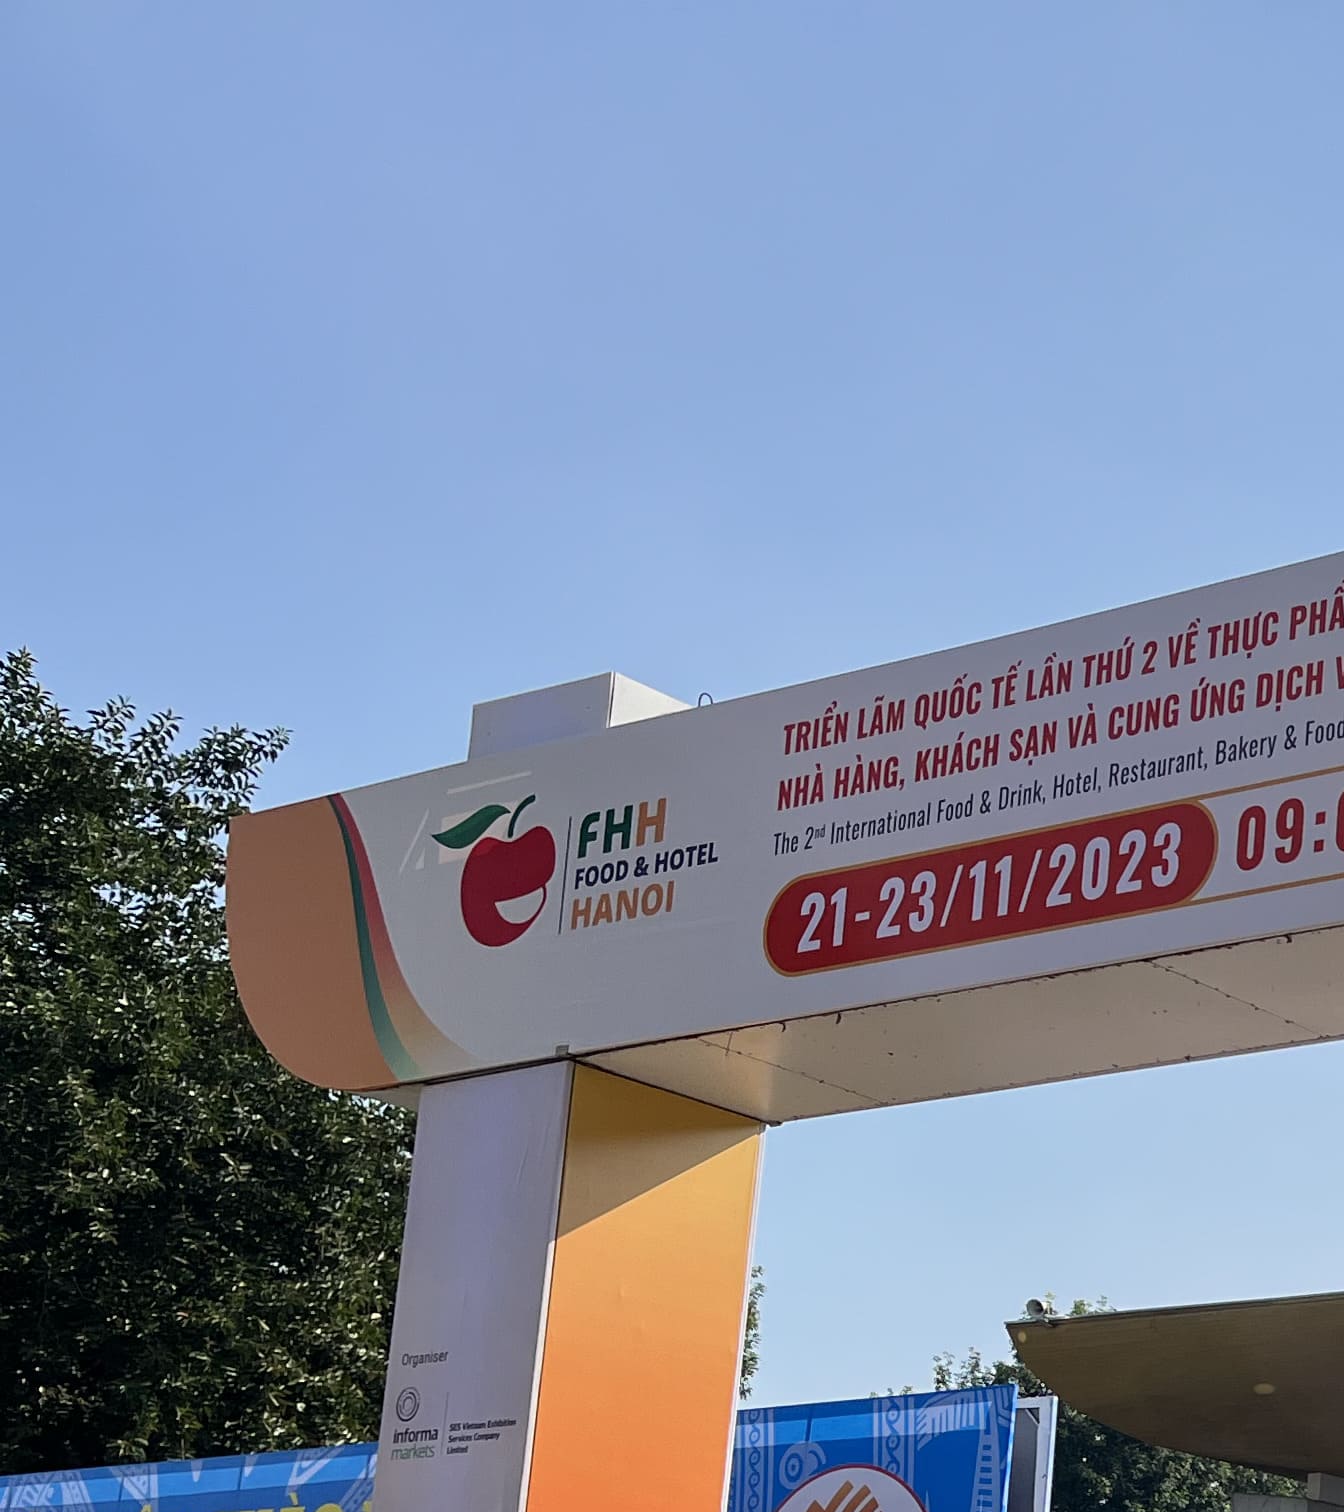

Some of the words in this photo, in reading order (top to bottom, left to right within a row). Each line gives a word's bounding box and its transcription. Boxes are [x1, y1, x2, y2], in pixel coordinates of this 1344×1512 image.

[783, 699, 849, 756] TRIỂN
[856, 694, 905, 741] LÃM
[913, 674, 982, 730] QUỐC
[991, 659, 1024, 710] TẾ
[1025, 651, 1074, 702] LẦN
[1083, 635, 1136, 687] THỨ
[1141, 641, 1160, 675] 2
[1168, 618, 1201, 668] VỀ
[1207, 610, 1280, 660] THỰC
[776, 761, 825, 812] NHÀ
[832, 746, 905, 801] HÀNG,
[914, 734, 1000, 784] KHÁCH
[1008, 721, 1057, 767] SẠN
[1067, 704, 1099, 747] VÀ
[1107, 693, 1180, 740] CUNG
[1189, 677, 1246, 722] ỨNG
[1256, 663, 1325, 713] DỊCH
[773, 831, 799, 858] The
[804, 822, 827, 852] 2nd
[830, 802, 932, 846] International
[936, 794, 974, 822] Food
[979, 791, 993, 815] &
[998, 781, 1047, 810] Drink,
[1052, 768, 1101, 800] Hotel,
[1108, 746, 1209, 787] Restaurant,
[1215, 731, 1278, 767] Bakery
[1284, 725, 1298, 750] &
[577, 798, 667, 859] FHH
[574, 860, 628, 890] FOOD
[633, 856, 650, 878] &
[654, 842, 719, 874] HOTEL
[796, 821, 1183, 954] 21-23/11/2023
[570, 880, 675, 931] HANOI
[401, 1351, 448, 1368] Organiser
[391, 1443, 436, 1460] markets
[393, 1428, 438, 1444] informa
